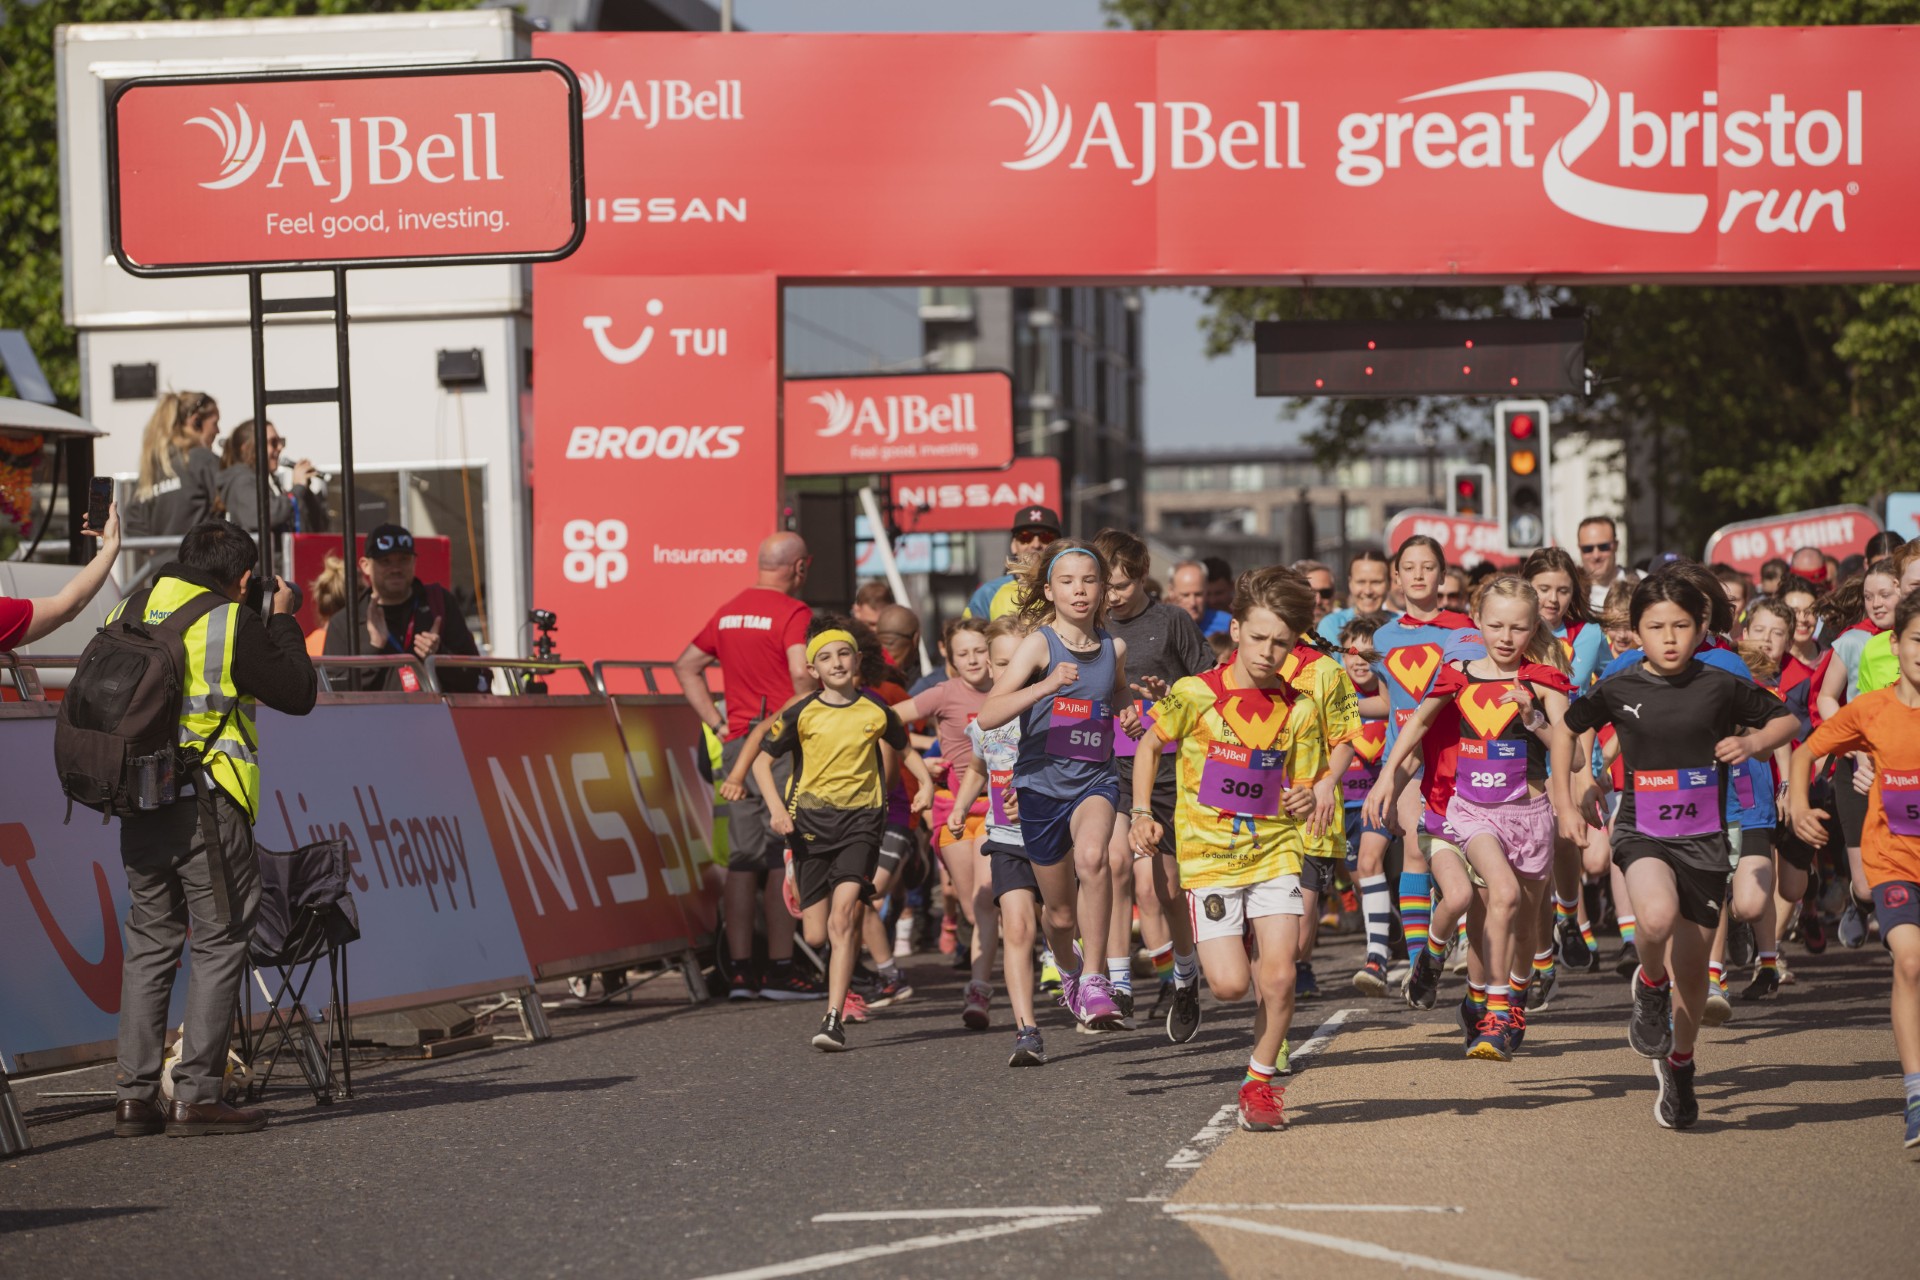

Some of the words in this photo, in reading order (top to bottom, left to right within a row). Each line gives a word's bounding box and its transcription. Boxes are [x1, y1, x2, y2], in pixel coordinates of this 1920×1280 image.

[1335, 95, 1535, 187] great
[1618, 90, 1864, 168] bristol
[266, 213, 315, 236] Feel
[322, 210, 390, 239] good,
[398, 206, 511, 233] investing.
[585, 198, 747, 222] ISSAN
[1718, 188, 1847, 234] run
[669, 328, 728, 356] TUI
[565, 426, 745, 459] BROOKS
[898, 482, 1045, 508] NISSAN
[1731, 531, 1768, 561] NO
[1769, 516, 1856, 553] T-SHIRT
[653, 544, 748, 564] Insurance
[1069, 730, 1103, 747] 516
[1220, 778, 1264, 799] 309
[1471, 772, 1507, 788] 292
[1658, 803, 1698, 820] 274
[487, 746, 714, 916] NISSA
[275, 789, 370, 892] Le
[353, 785, 476, 913] Happy
